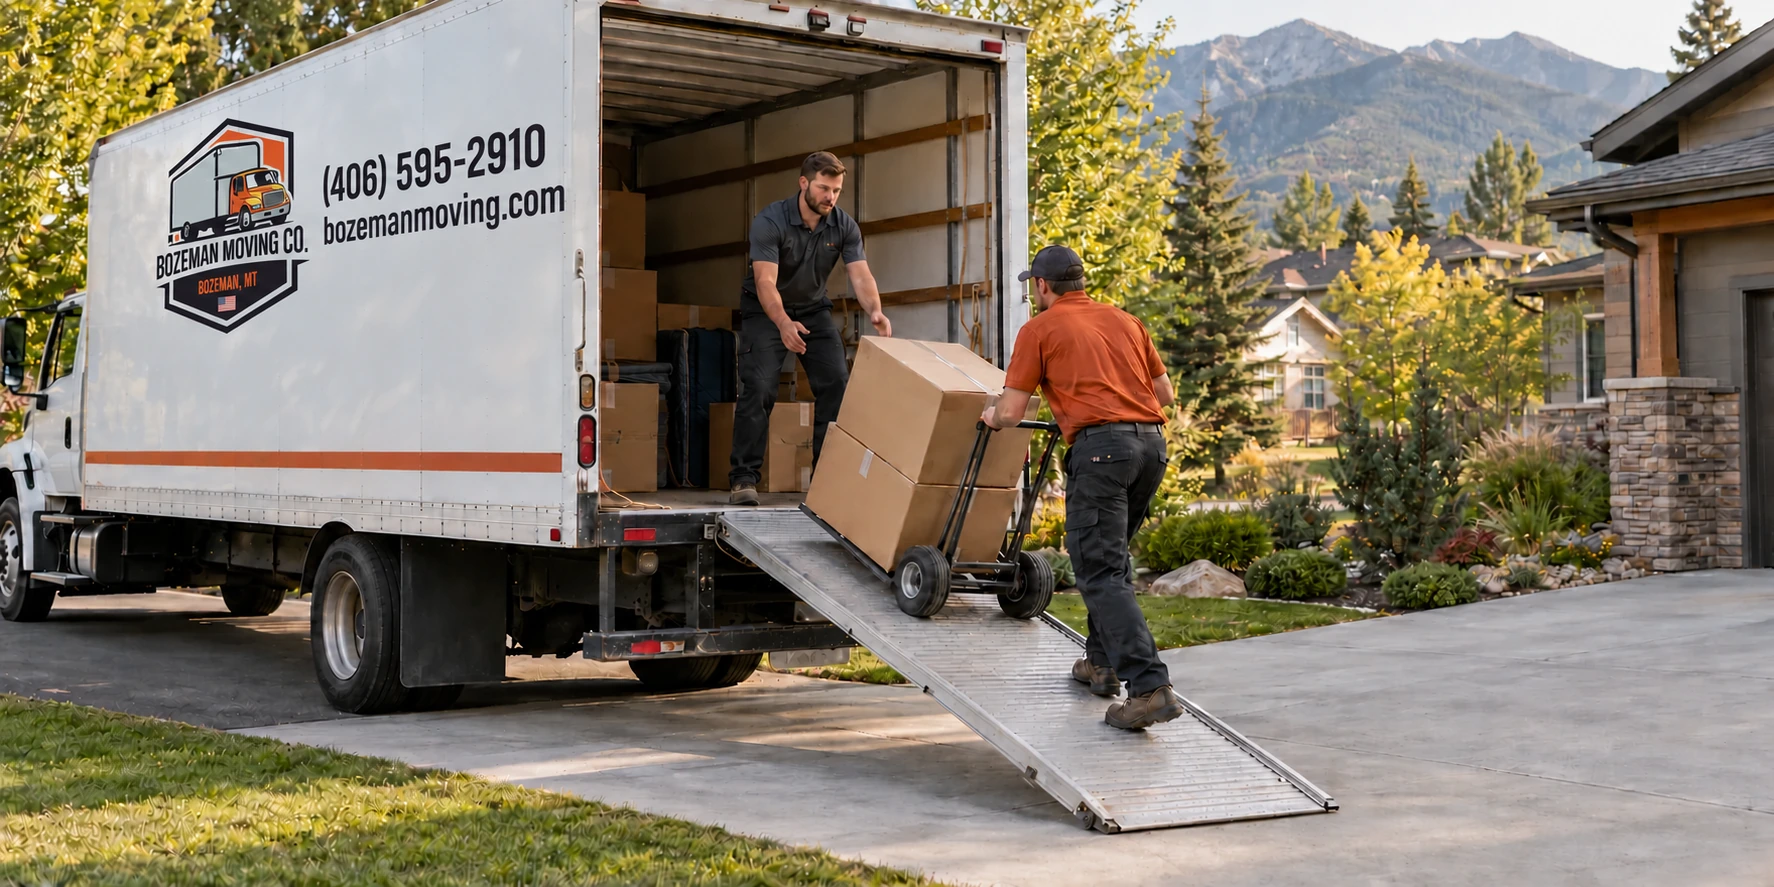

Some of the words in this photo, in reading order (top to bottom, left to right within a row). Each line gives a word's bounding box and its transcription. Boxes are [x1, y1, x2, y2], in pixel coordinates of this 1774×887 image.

[323, 153, 387, 208] (406)
[396, 123, 546, 191] 595-2910
[323, 184, 565, 246] bozemanmoving.com
[156, 241, 219, 281] BOZEMAN
[222, 230, 279, 262] MOVING
[283, 225, 309, 254] CO.
[197, 274, 242, 295] BOZEMAN,
[243, 270, 258, 288] MT
